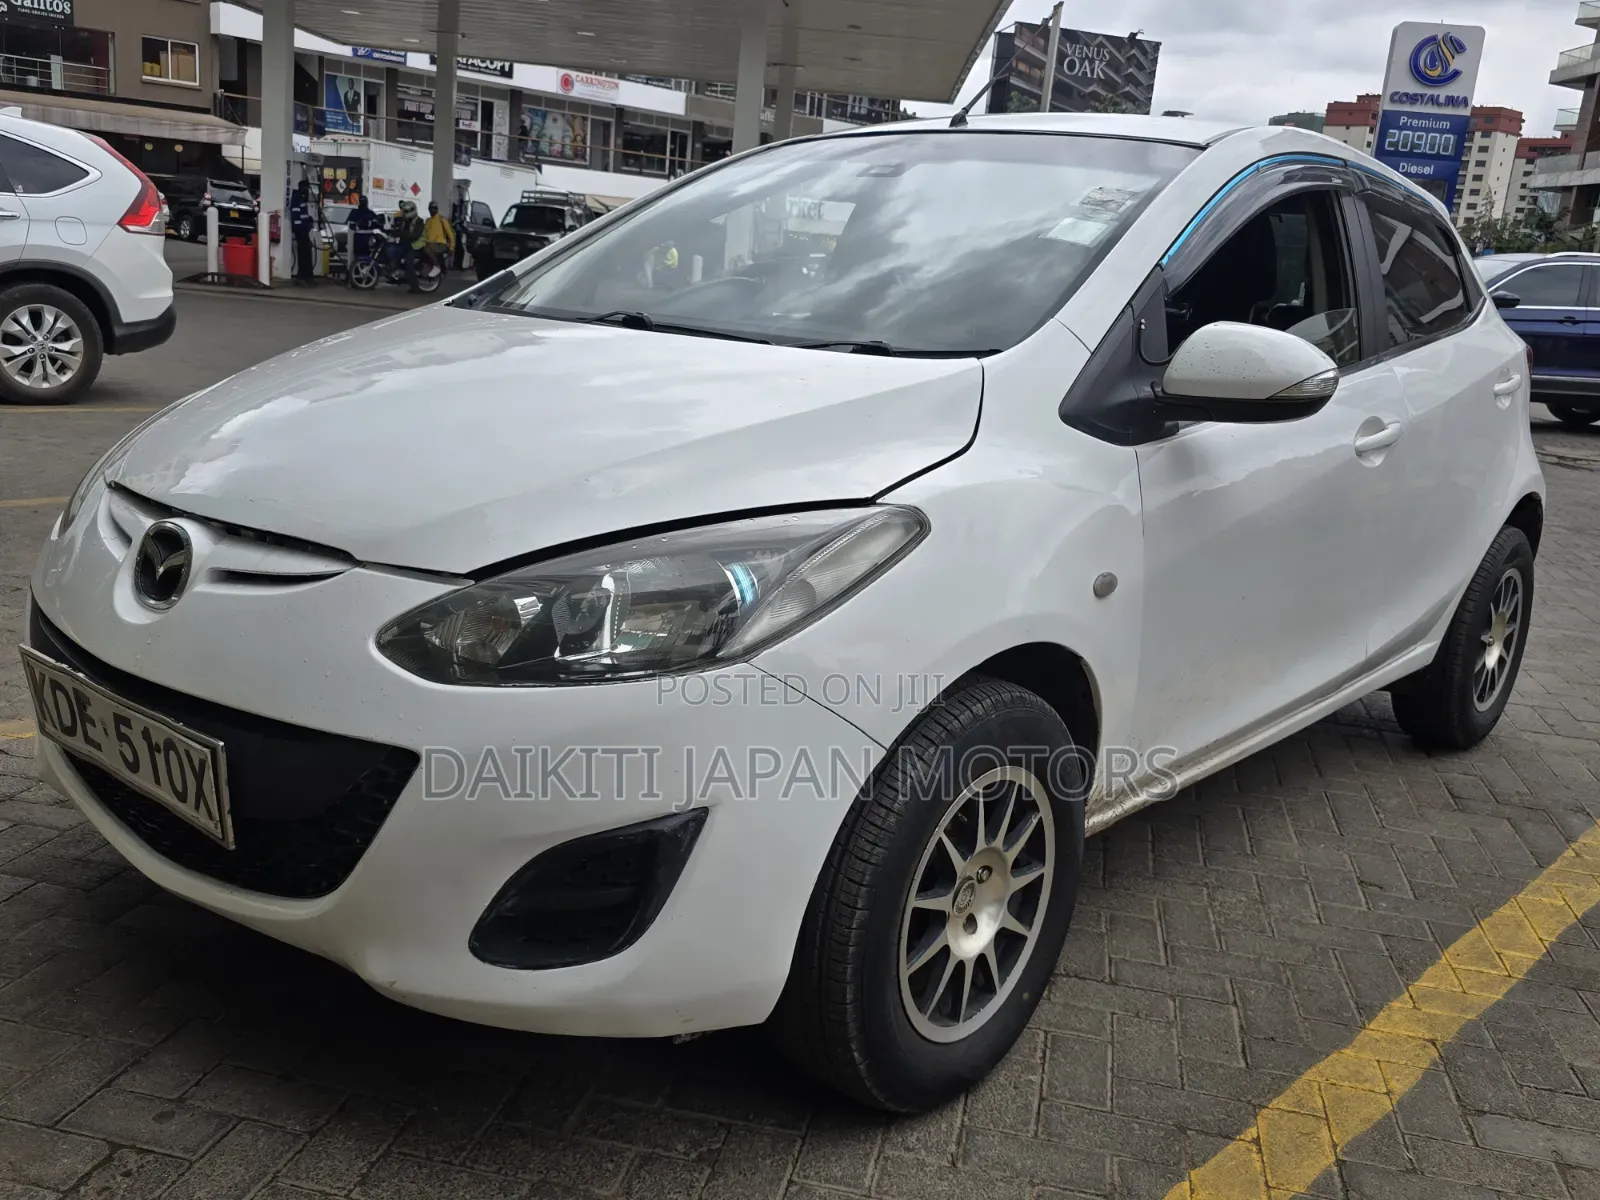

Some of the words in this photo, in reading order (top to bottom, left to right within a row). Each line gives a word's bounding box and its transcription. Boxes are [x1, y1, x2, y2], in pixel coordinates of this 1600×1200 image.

[1066, 43, 1110, 61] VENUS
[1063, 56, 1107, 80] OAK
[575, 75, 620, 90] CARRINGTON
[1389, 91, 1469, 109] COSTALINA
[1399, 116, 1450, 130] Premium
[1399, 162, 1434, 175] Diesel
[27, 661, 103, 753] KDE
[113, 711, 216, 822] 510X
